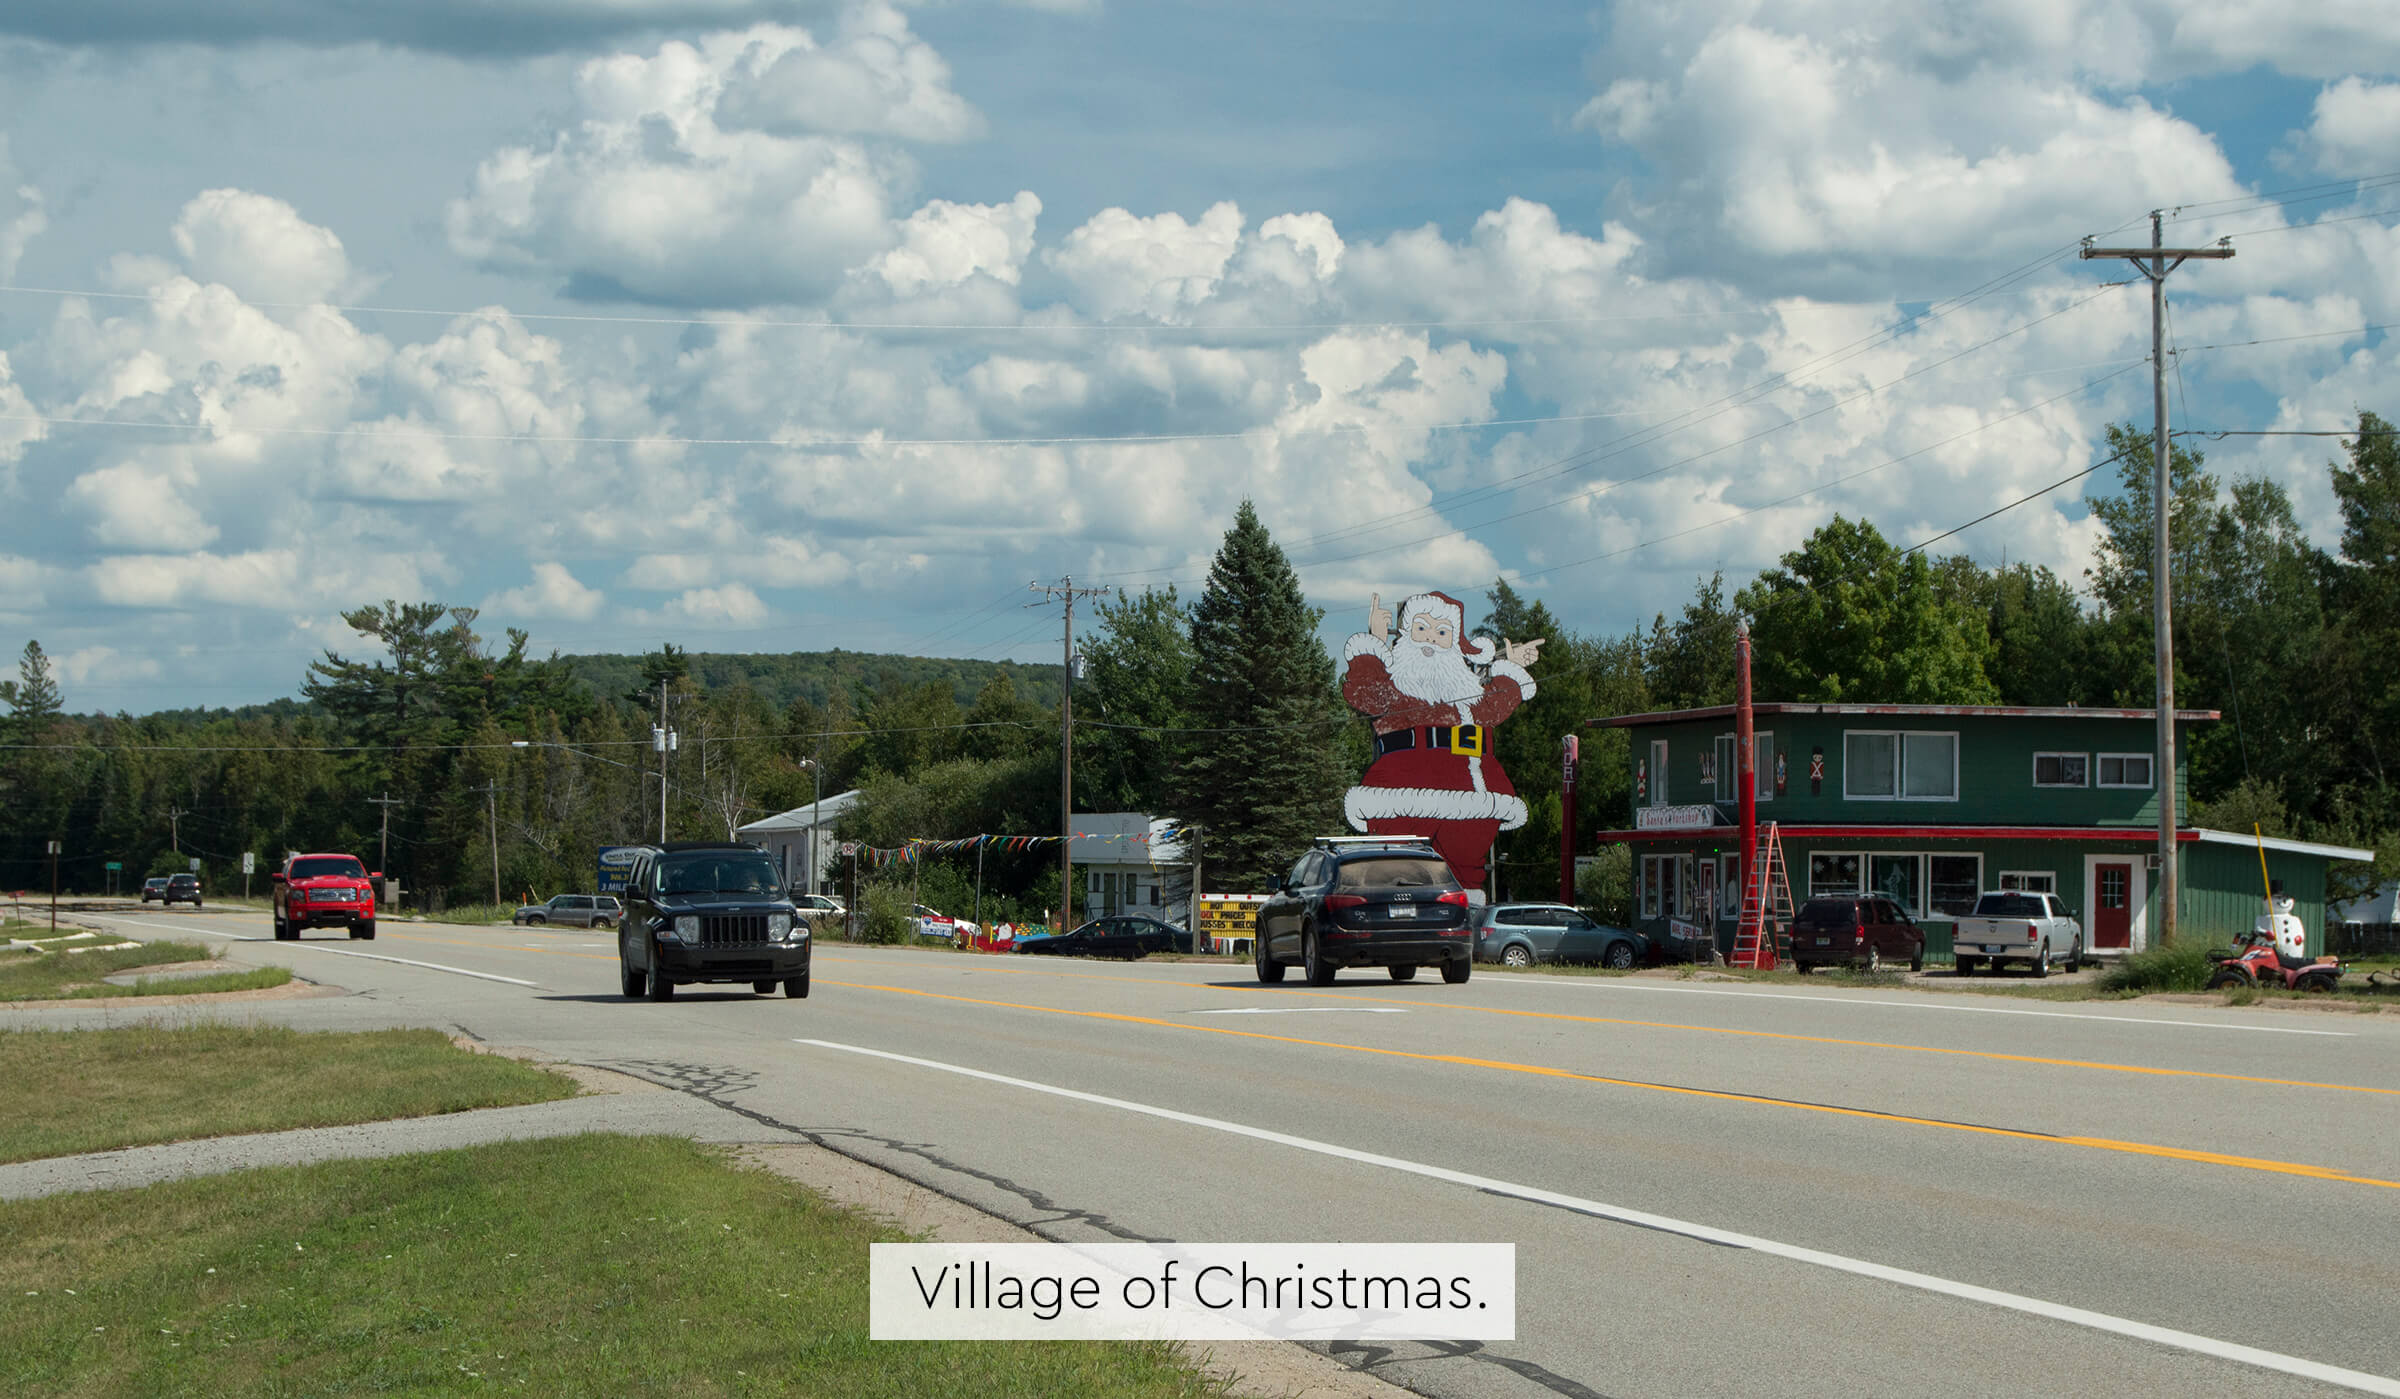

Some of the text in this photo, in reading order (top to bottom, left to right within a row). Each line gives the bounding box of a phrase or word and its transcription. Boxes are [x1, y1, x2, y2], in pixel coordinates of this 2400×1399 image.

[608, 882, 628, 891] MILE
[1239, 902, 1259, 911] OUTS
[1200, 910, 1246, 920] OOL PRICES
[1232, 920, 1257, 929] WELCO
